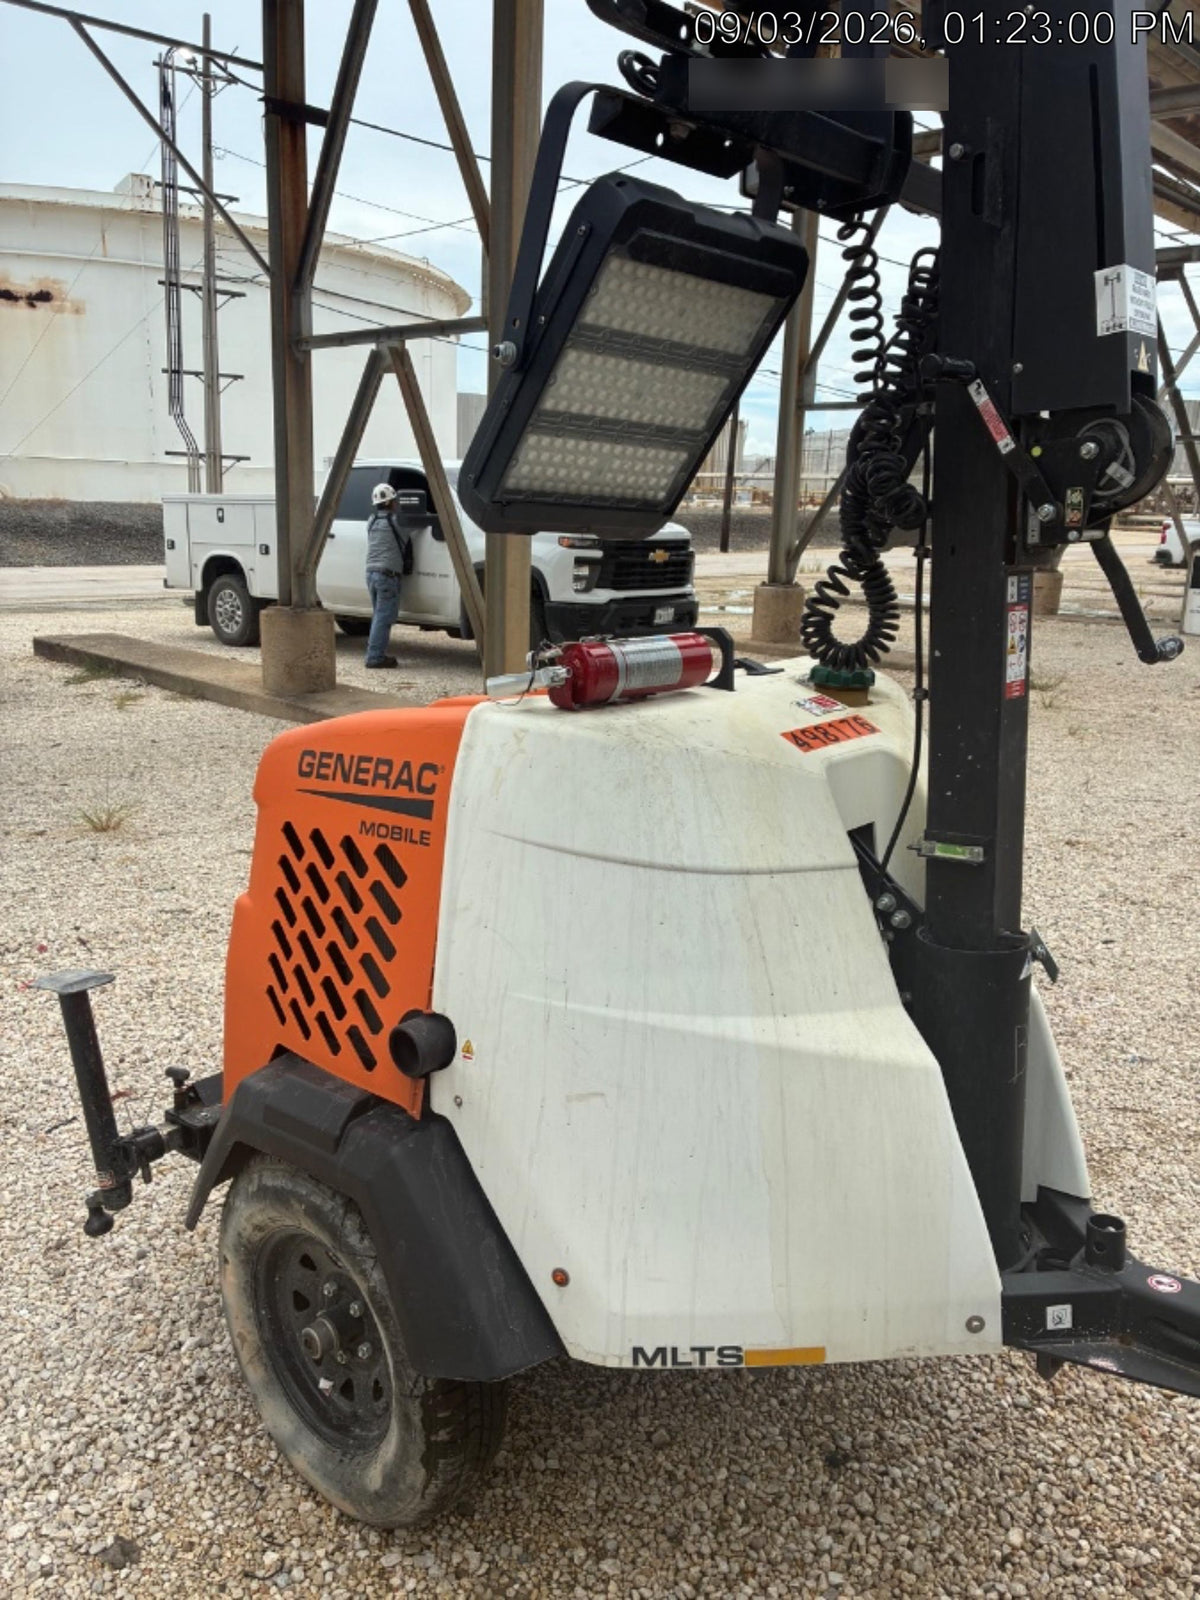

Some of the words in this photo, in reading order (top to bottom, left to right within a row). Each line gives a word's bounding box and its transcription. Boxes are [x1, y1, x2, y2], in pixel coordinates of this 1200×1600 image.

[789, 714, 879, 750] 498176
[297, 749, 438, 795] GENERAC
[359, 820, 431, 847] MOBILE
[632, 1345, 744, 1367] MLTS
